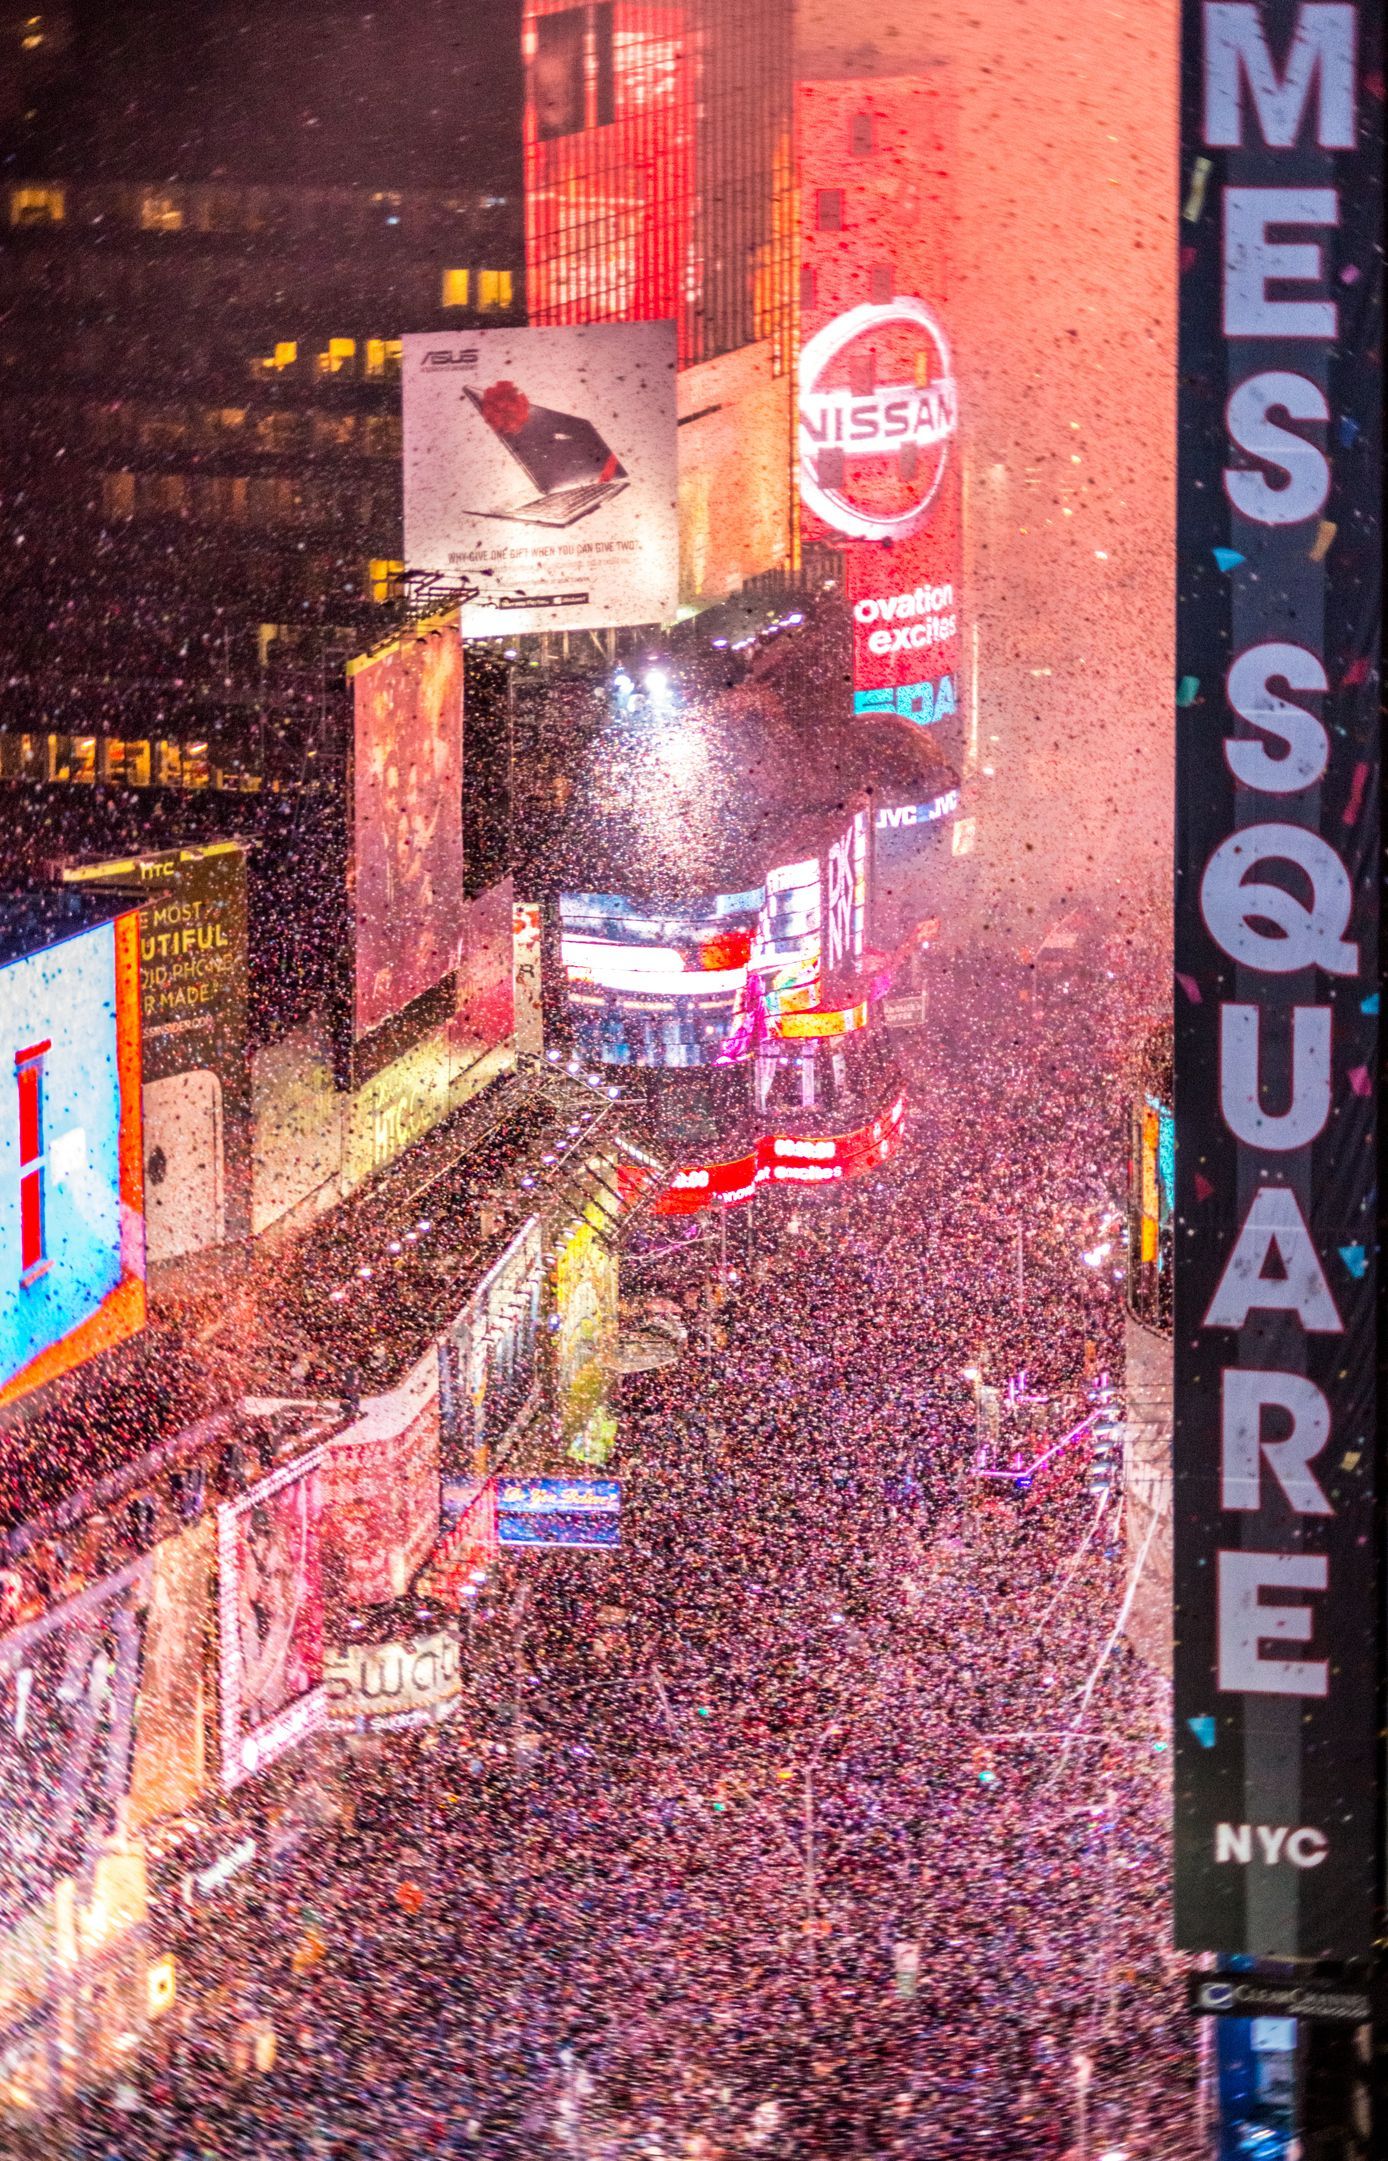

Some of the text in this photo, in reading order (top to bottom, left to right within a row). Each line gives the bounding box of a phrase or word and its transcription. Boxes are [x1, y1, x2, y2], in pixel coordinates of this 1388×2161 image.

[420, 349, 479, 365] ASUS
[800, 394, 954, 443] NISSAN
[469, 550, 487, 562] GIVE
[491, 550, 506, 561] ONE
[531, 546, 555, 557] WHEN
[558, 545, 573, 556] YOU
[577, 543, 593, 554] CAN
[595, 542, 613, 552] GIVE
[868, 614, 957, 654] excites
[875, 805, 918, 829] JVC
[153, 901, 202, 927] MOST
[141, 924, 229, 961] UTIFUL
[1201, 643, 1358, 1695] SQUARE
[1215, 1824, 1328, 1869] NYC
